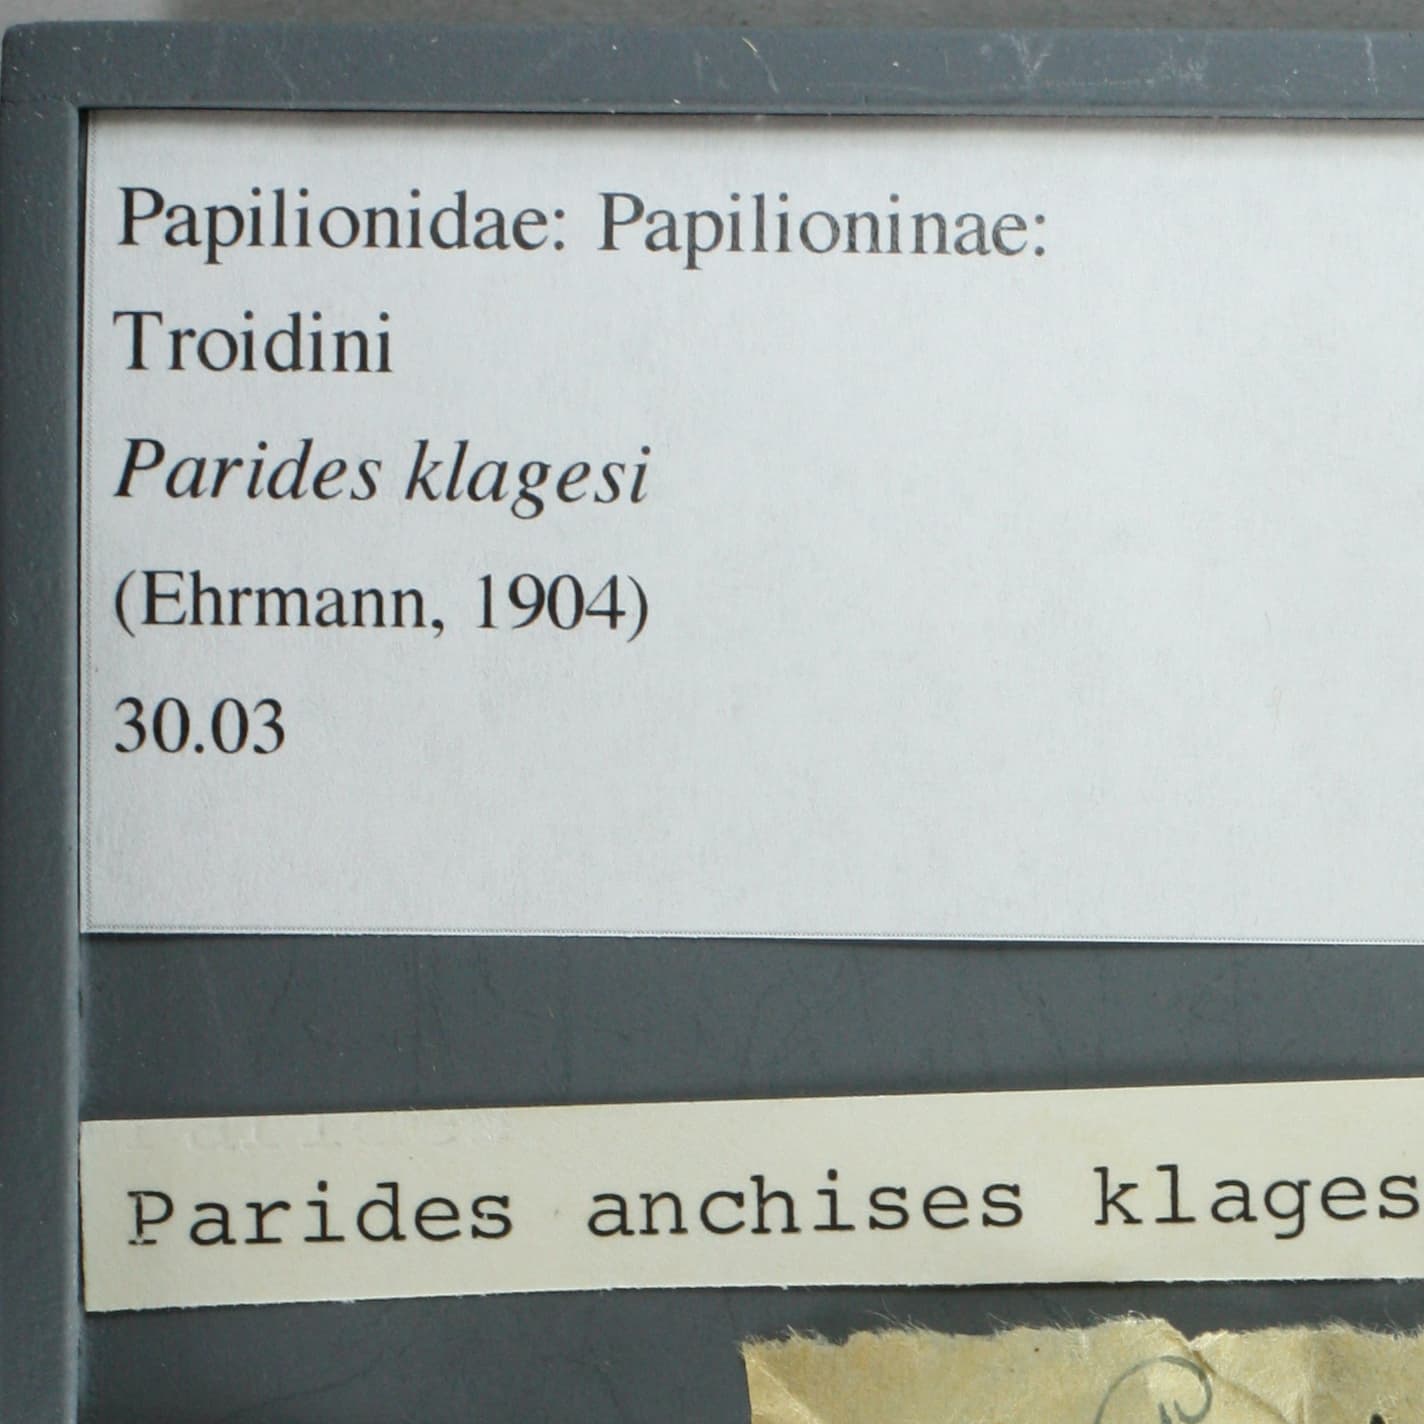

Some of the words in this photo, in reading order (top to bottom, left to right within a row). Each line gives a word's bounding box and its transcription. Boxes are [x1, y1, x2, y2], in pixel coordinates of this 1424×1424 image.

[117, 186, 565, 265] Papilionidae:
[597, 191, 1046, 271] Papilioninae:
[112, 309, 392, 373] Troidini
[113, 437, 382, 501] Parides
[404, 438, 651, 520] klagesi
[114, 569, 445, 638] (Ehrmann,
[476, 573, 649, 642] 1904)
[114, 696, 285, 755] 30.03
[126, 1179, 513, 1247] Parides
[587, 1168, 1023, 1238] anchises
